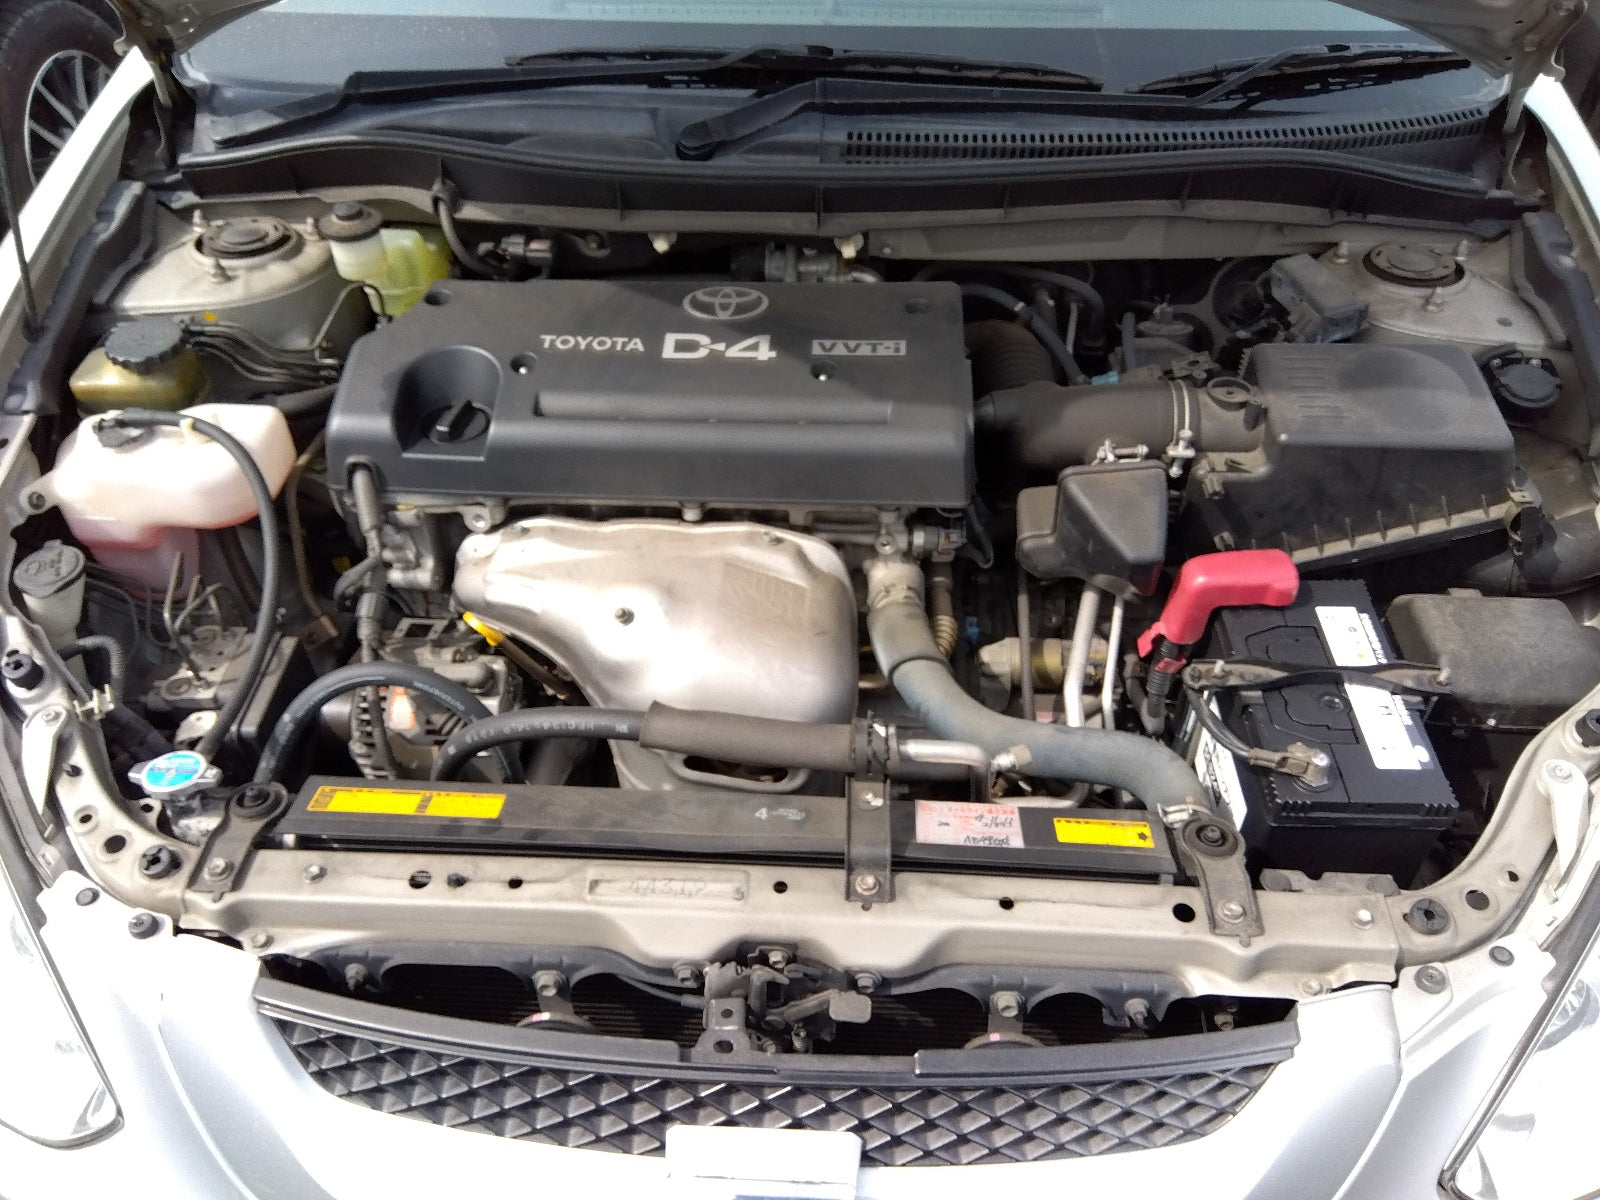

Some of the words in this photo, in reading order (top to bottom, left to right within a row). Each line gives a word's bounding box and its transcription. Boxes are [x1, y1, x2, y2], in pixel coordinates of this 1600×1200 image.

[539, 334, 646, 352] TOYOTA
[661, 332, 778, 361] D-4
[812, 340, 907, 355] VVT-i
